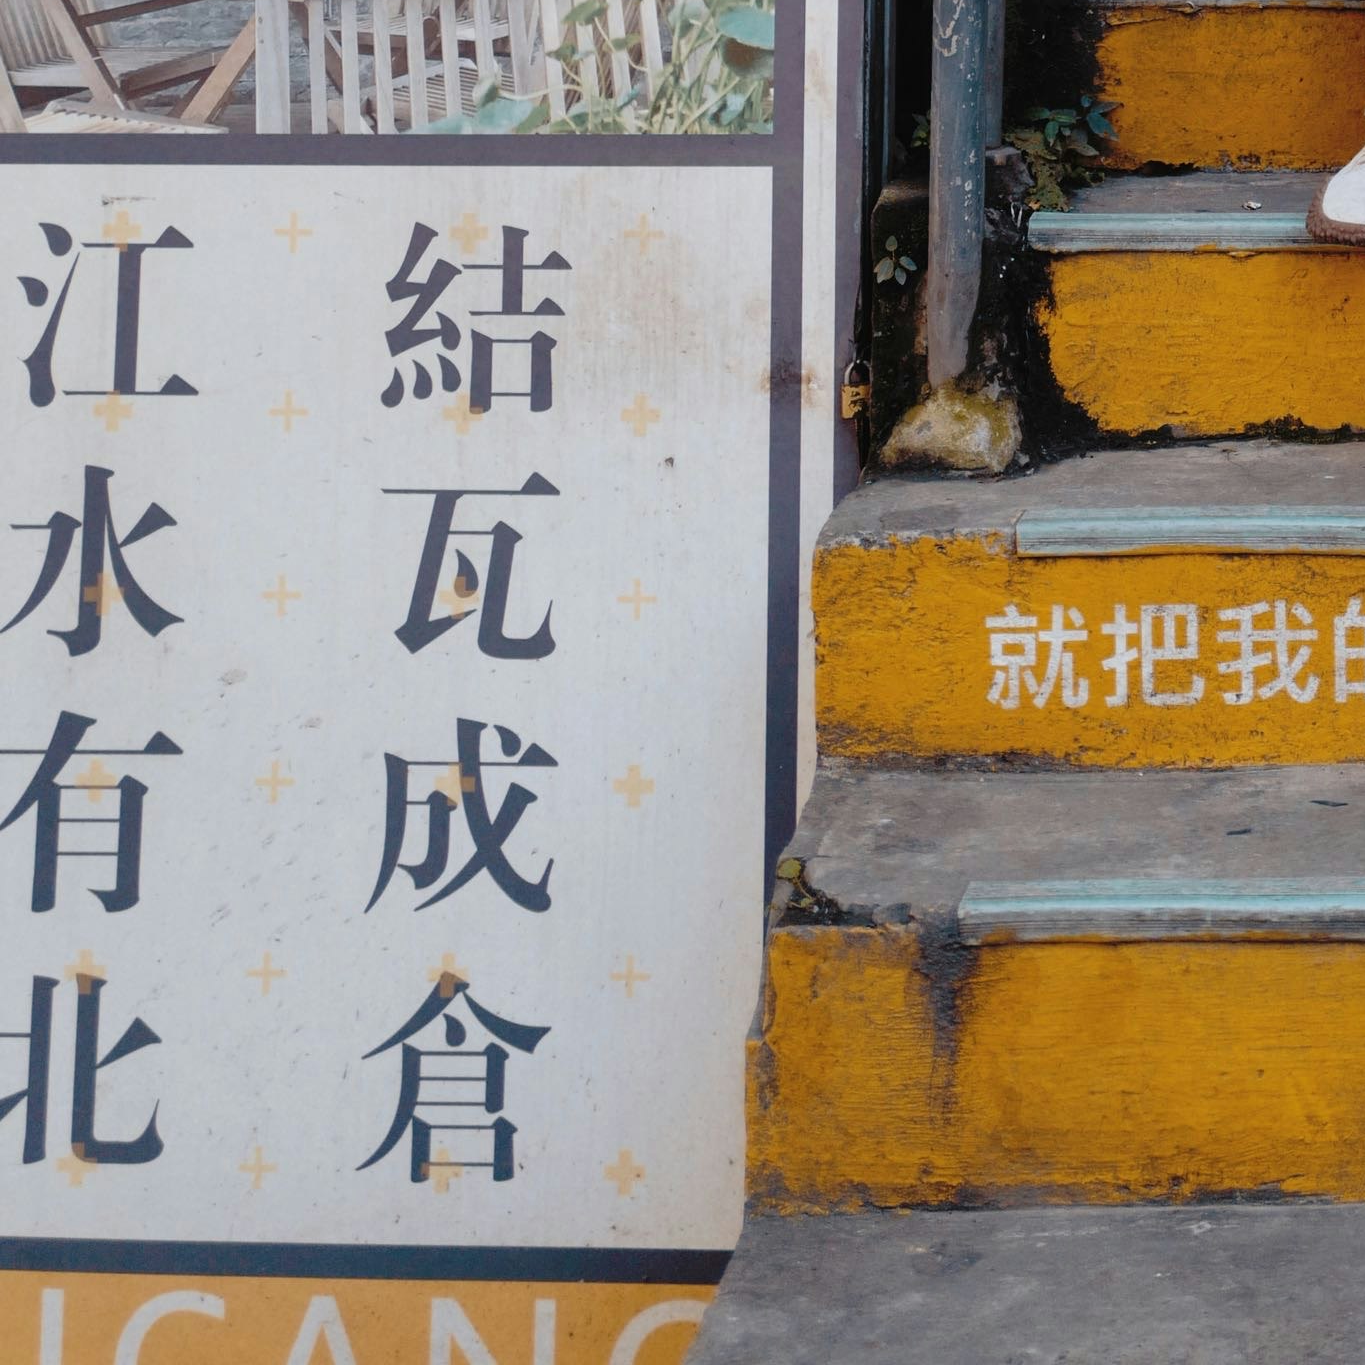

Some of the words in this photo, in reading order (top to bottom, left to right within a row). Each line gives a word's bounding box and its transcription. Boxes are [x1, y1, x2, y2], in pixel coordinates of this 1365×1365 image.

[0, 221, 199, 1167] 江水有北
[356, 220, 572, 1184] 結瓦成倉
